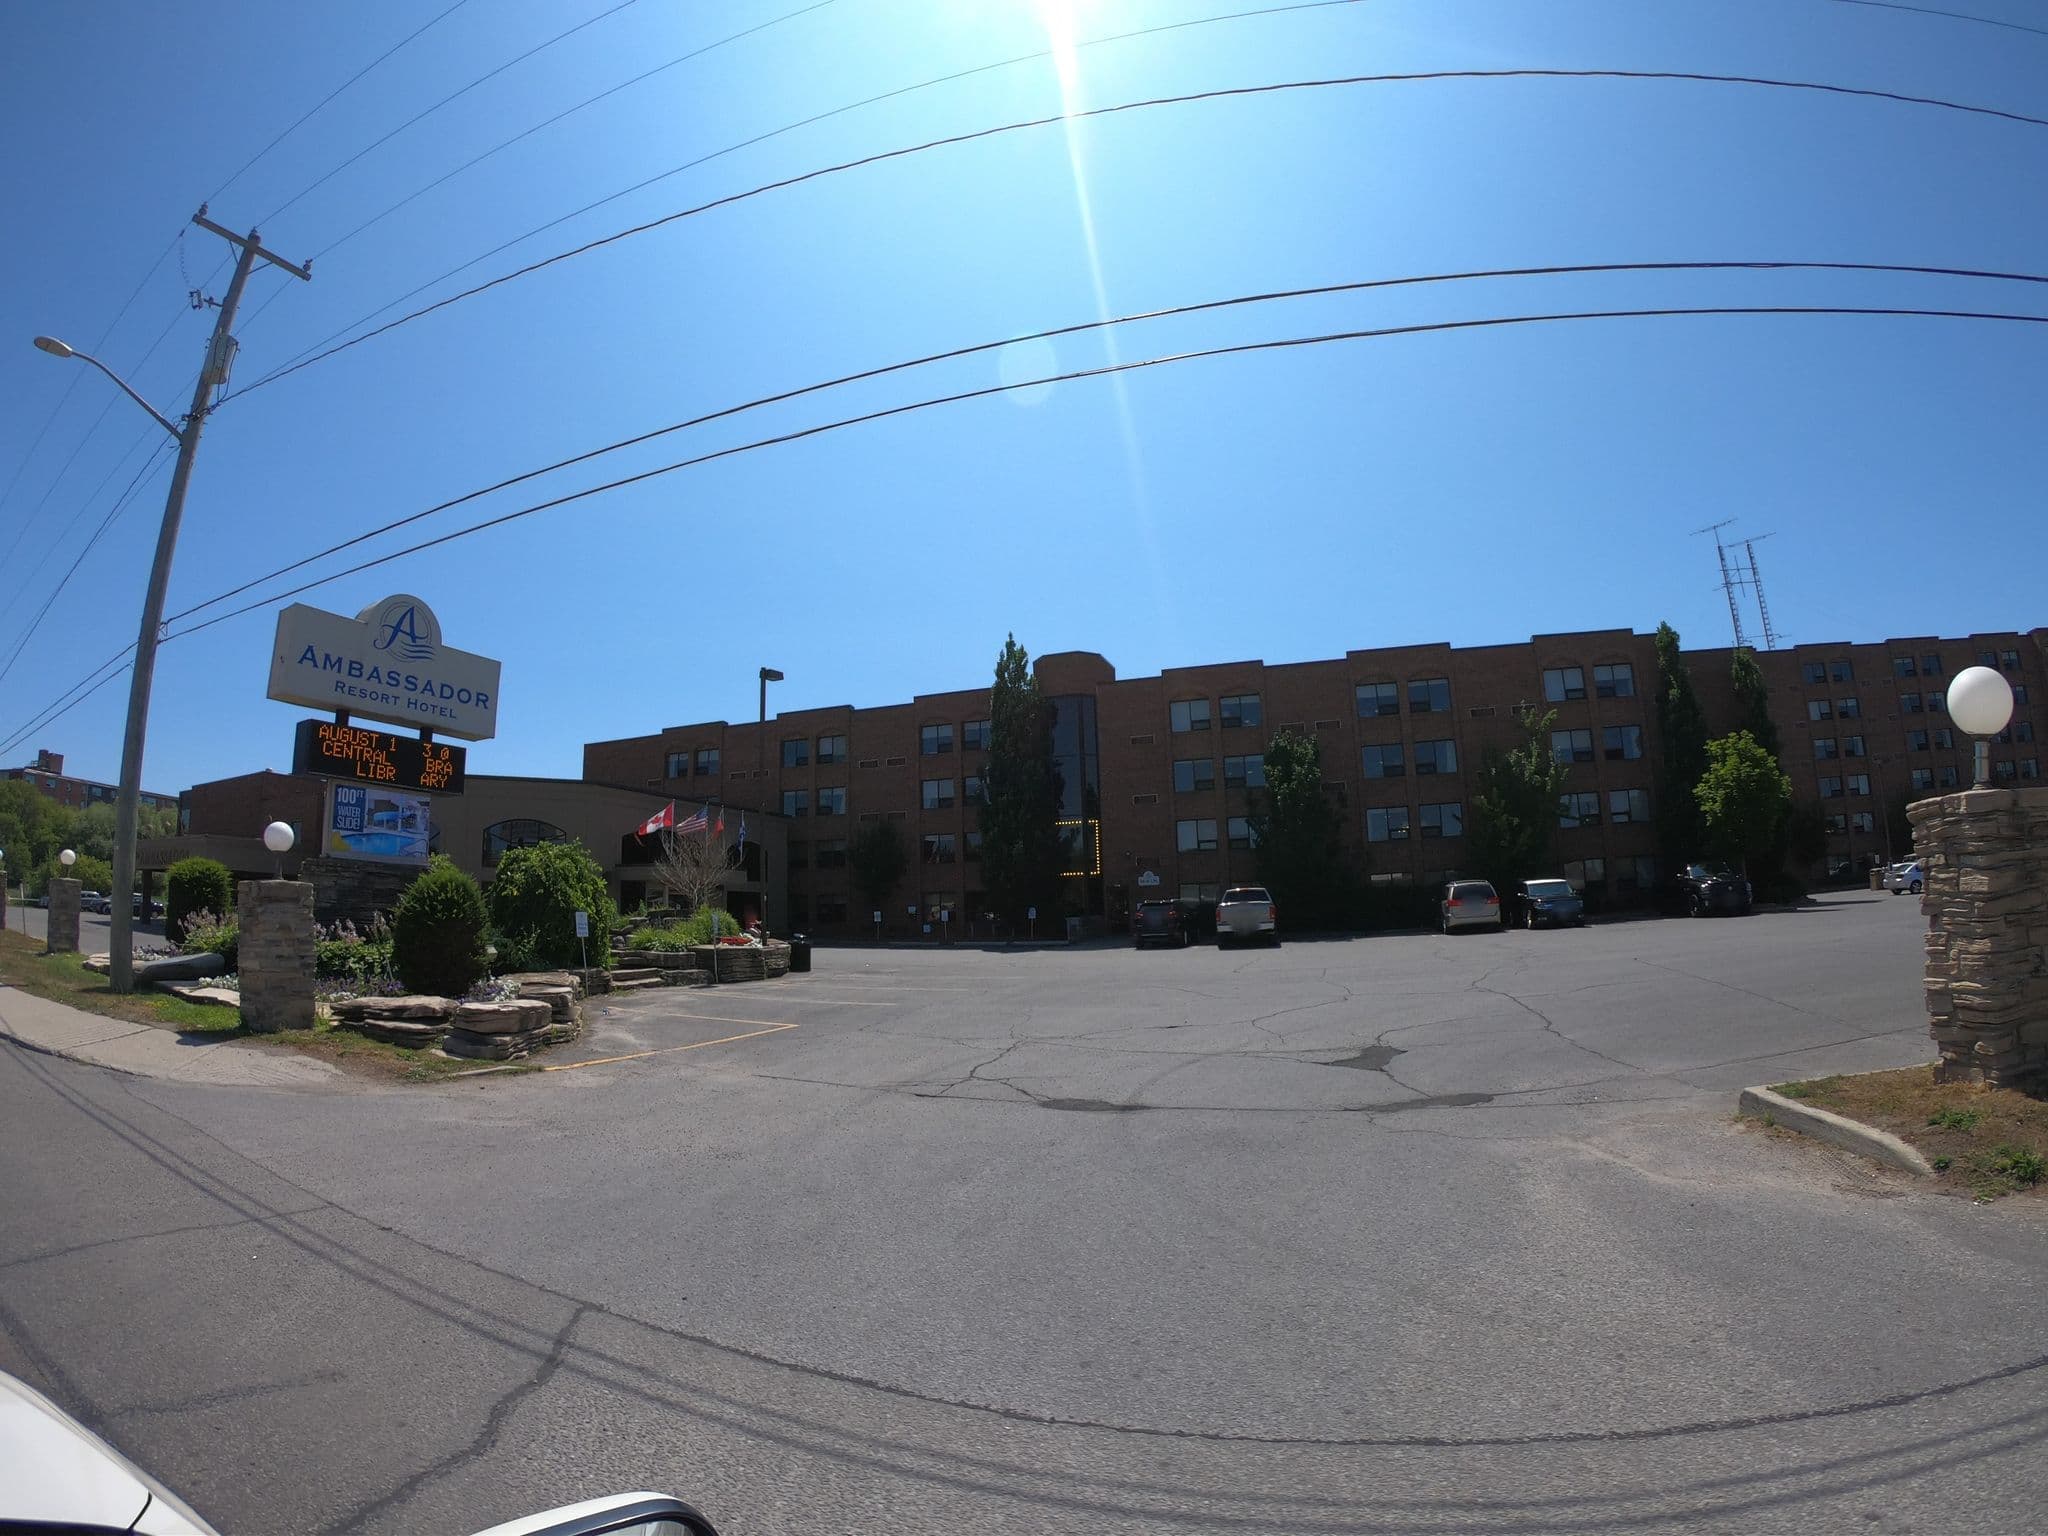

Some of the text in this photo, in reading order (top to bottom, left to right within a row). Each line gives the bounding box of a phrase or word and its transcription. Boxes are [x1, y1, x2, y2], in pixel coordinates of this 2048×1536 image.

[297, 645, 489, 710] AMBASSADOR
[334, 680, 457, 719] RESORT HOTEL
[319, 724, 379, 748] AUGUST
[390, 737, 396, 752] 1
[422, 743, 432, 758] 3
[322, 740, 453, 776] CENTRAL BRA
[357, 762, 448, 789] LIBR ARY
[336, 815, 362, 830] SLIDE!
[337, 805, 362, 818] WATER
